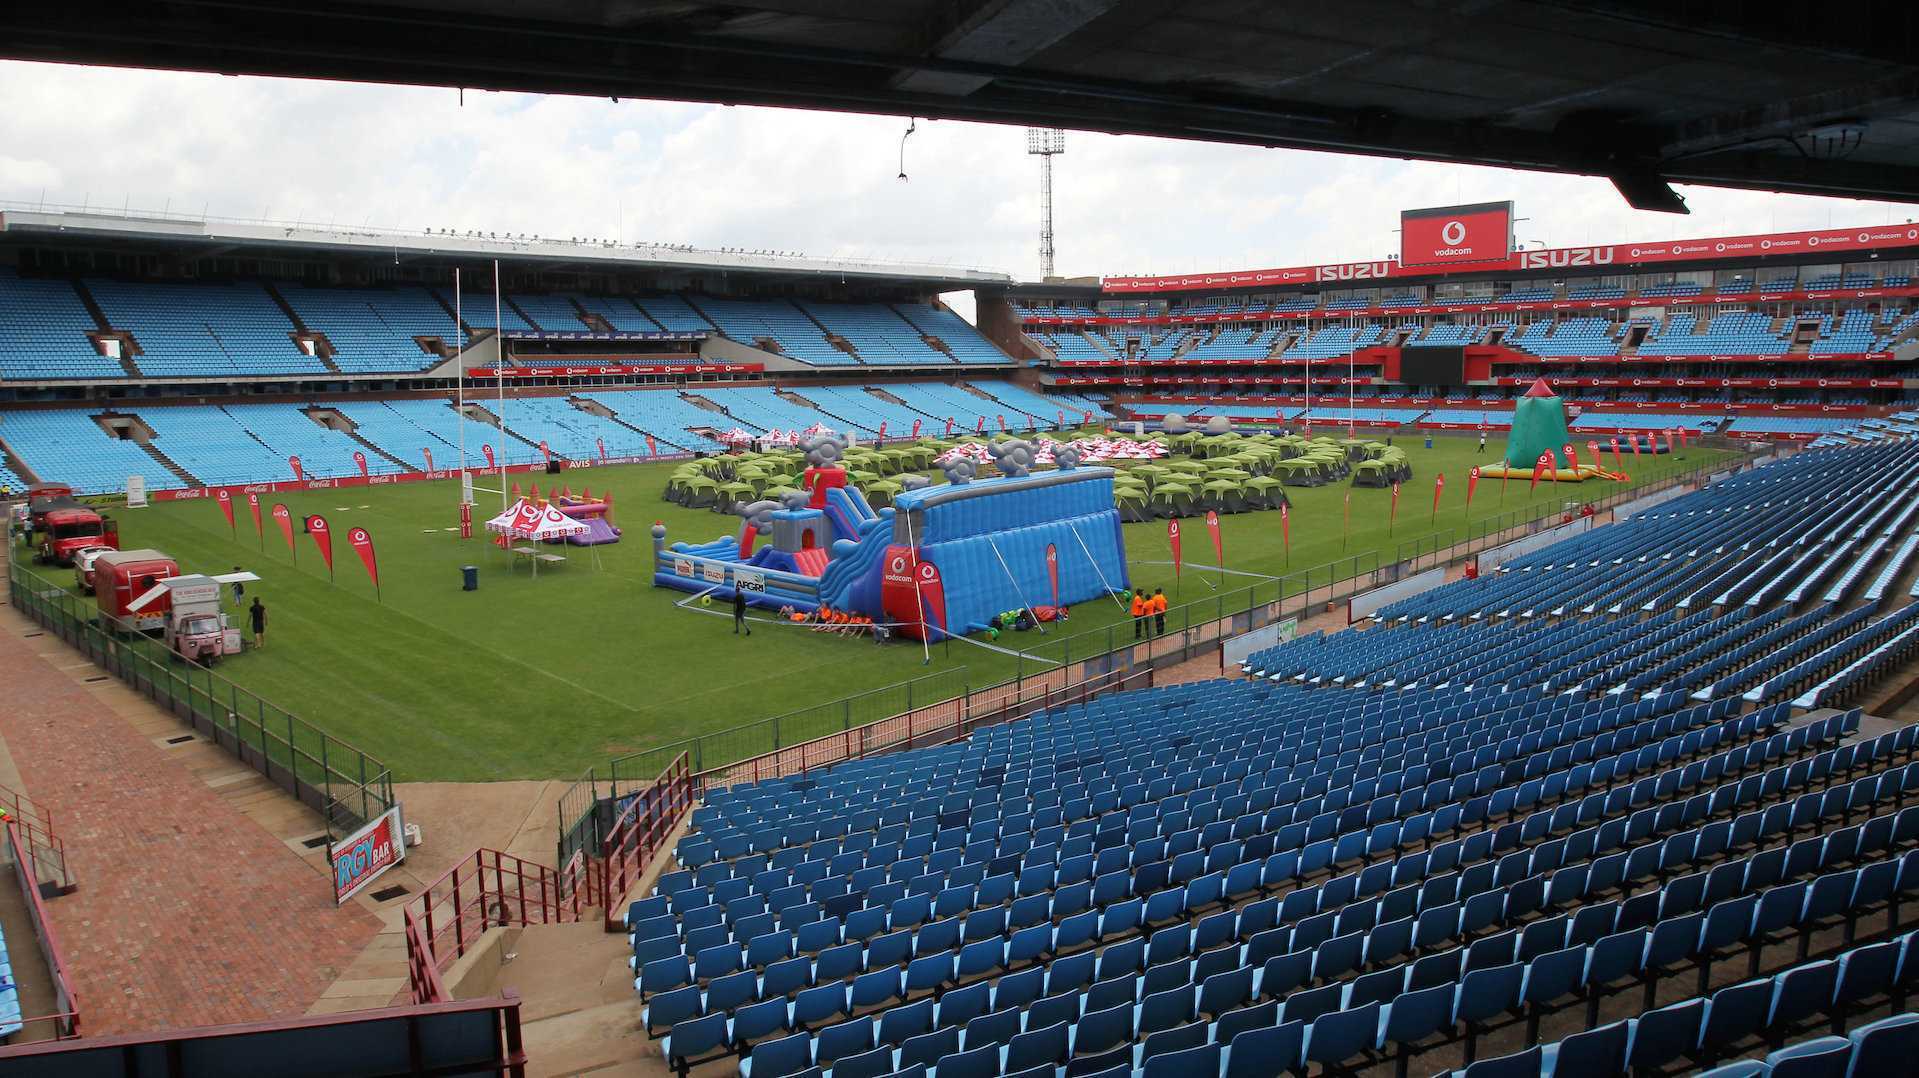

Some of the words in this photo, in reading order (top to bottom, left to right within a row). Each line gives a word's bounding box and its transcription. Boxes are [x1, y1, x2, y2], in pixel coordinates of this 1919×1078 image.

[1434, 247, 1472, 256] vodacom
[1521, 247, 1614, 270] ISUZU
[1315, 262, 1389, 281] ISUZU
[569, 459, 591, 469] AVIS
[335, 835, 376, 889] RGY
[373, 841, 390, 865] BAR
